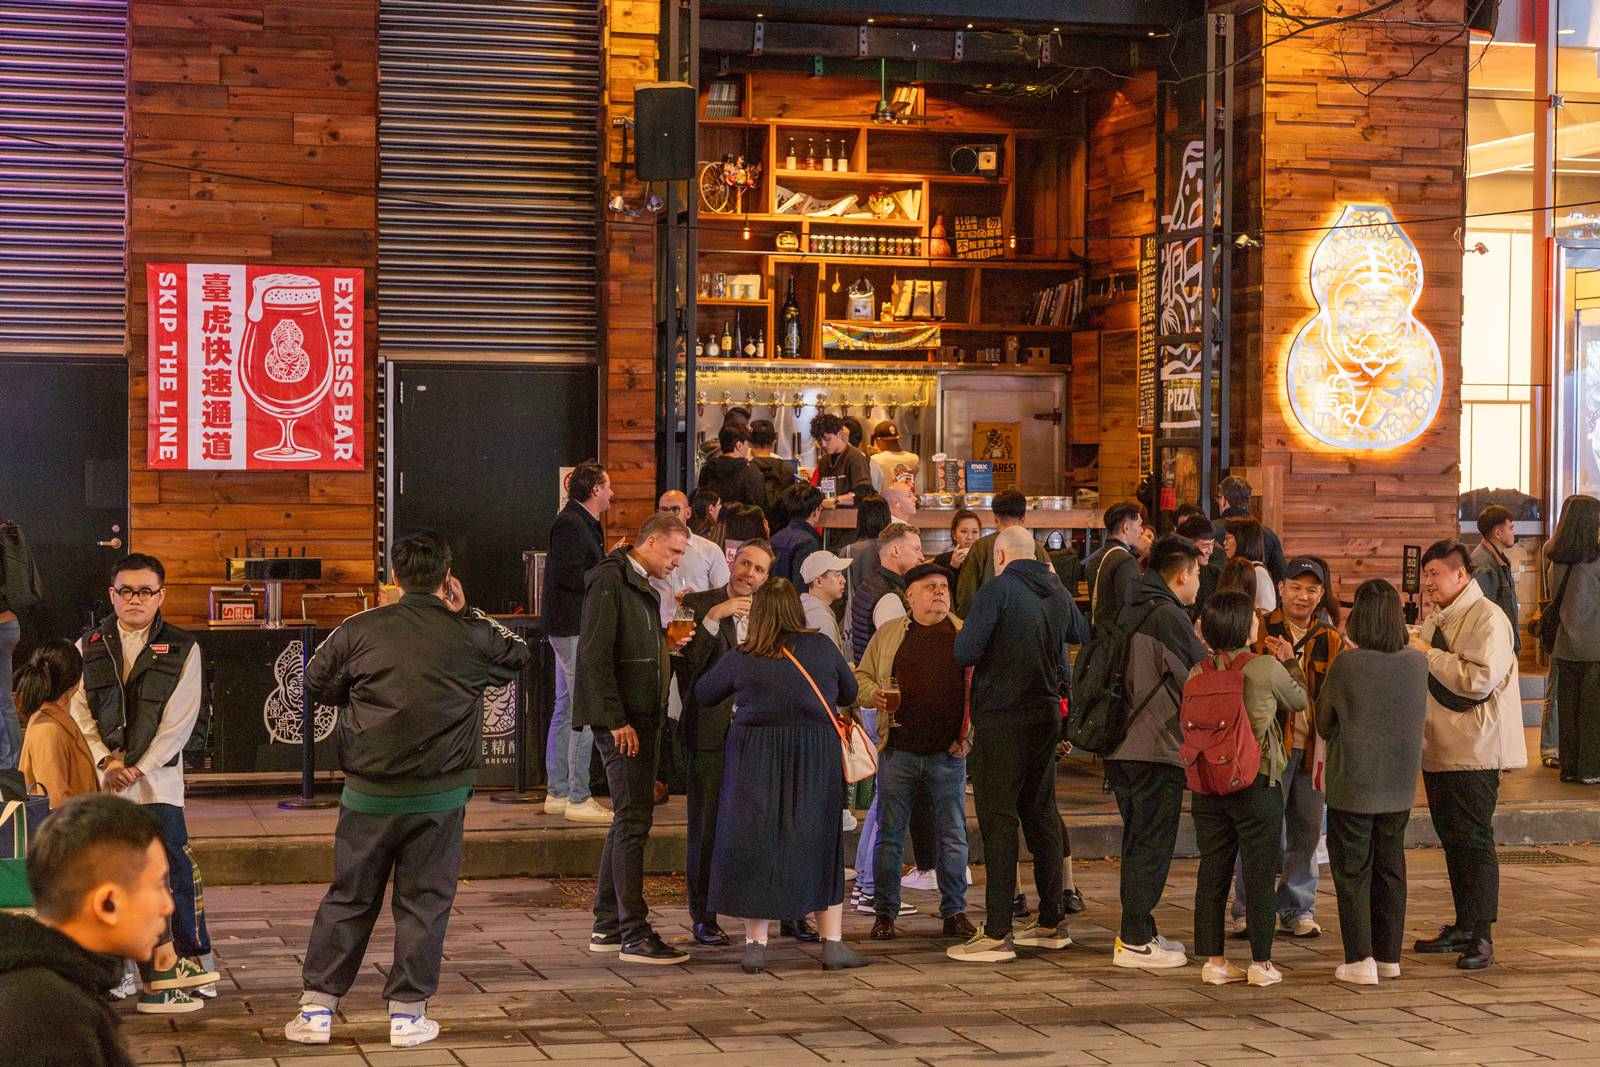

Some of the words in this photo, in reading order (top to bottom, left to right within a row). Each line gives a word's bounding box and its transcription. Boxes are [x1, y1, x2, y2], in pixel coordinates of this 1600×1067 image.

[159, 272, 177, 333] SKIP
[334, 277, 354, 397] EXPRESS
[159, 343, 178, 391] THE
[1167, 387, 1196, 411] PIZZA
[159, 401, 178, 460] LINE
[334, 405, 354, 461] BAR
